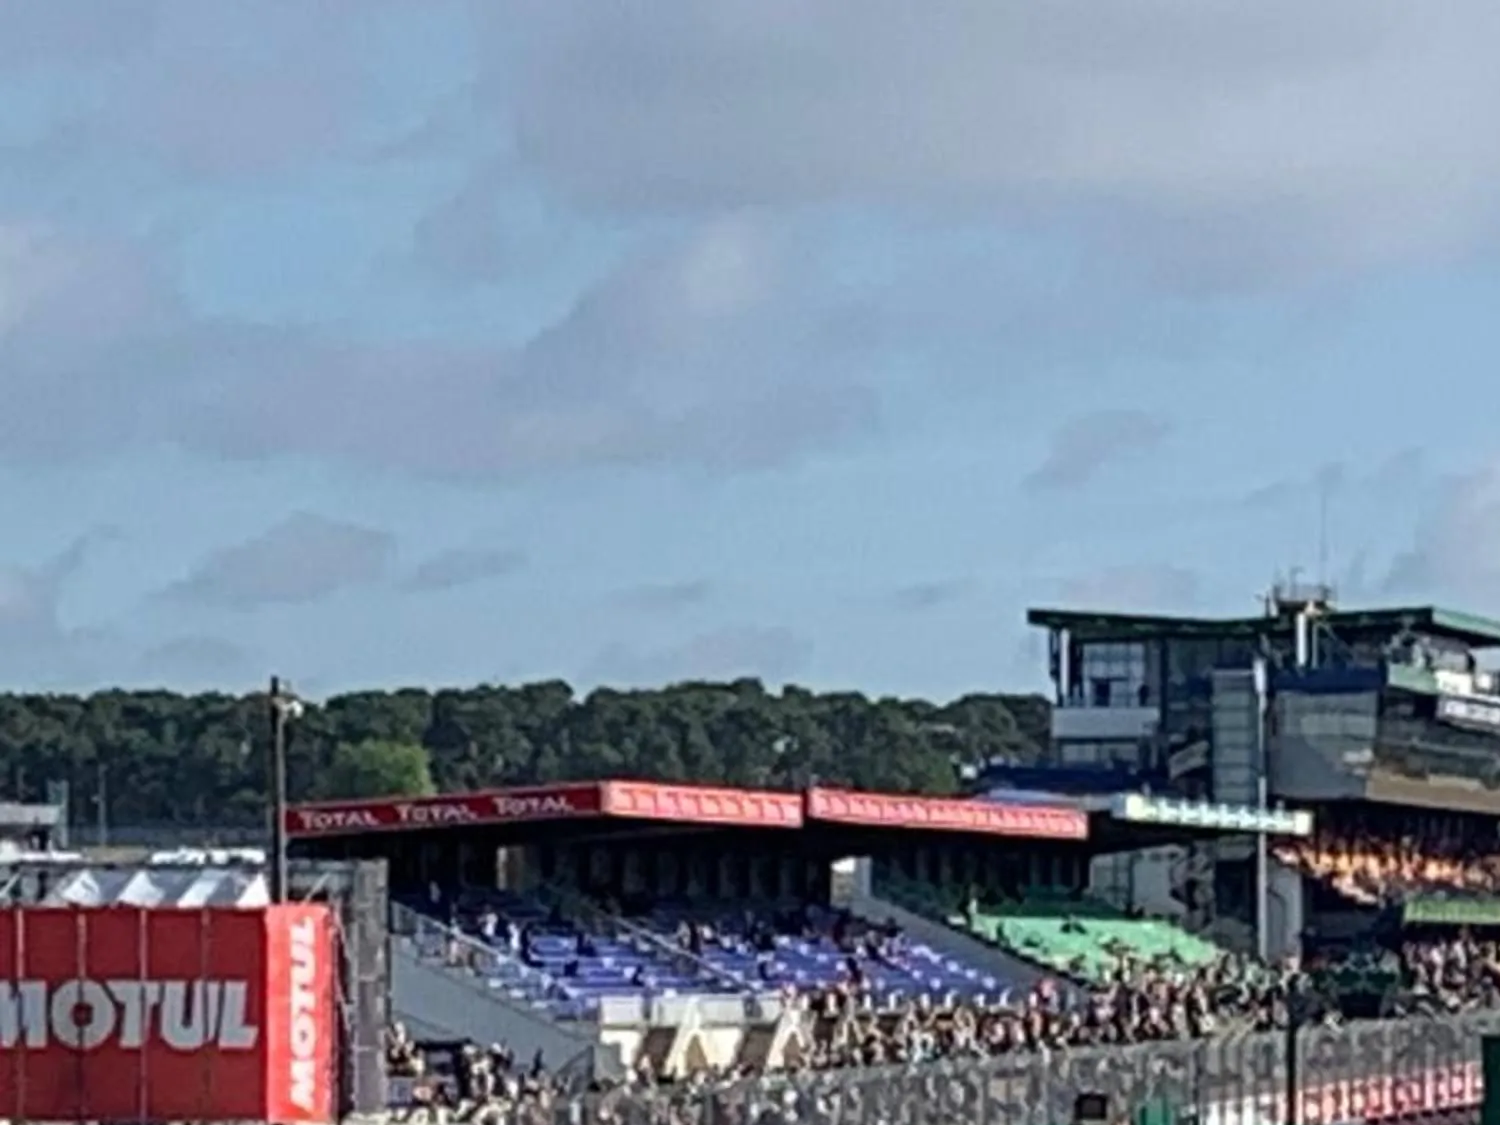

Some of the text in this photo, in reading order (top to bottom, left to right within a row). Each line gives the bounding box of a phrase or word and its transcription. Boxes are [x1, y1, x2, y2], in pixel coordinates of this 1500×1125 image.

[299, 795, 576, 830] TOTAL TOTAL TOTAL
[290, 914, 316, 1113] MOTUL
